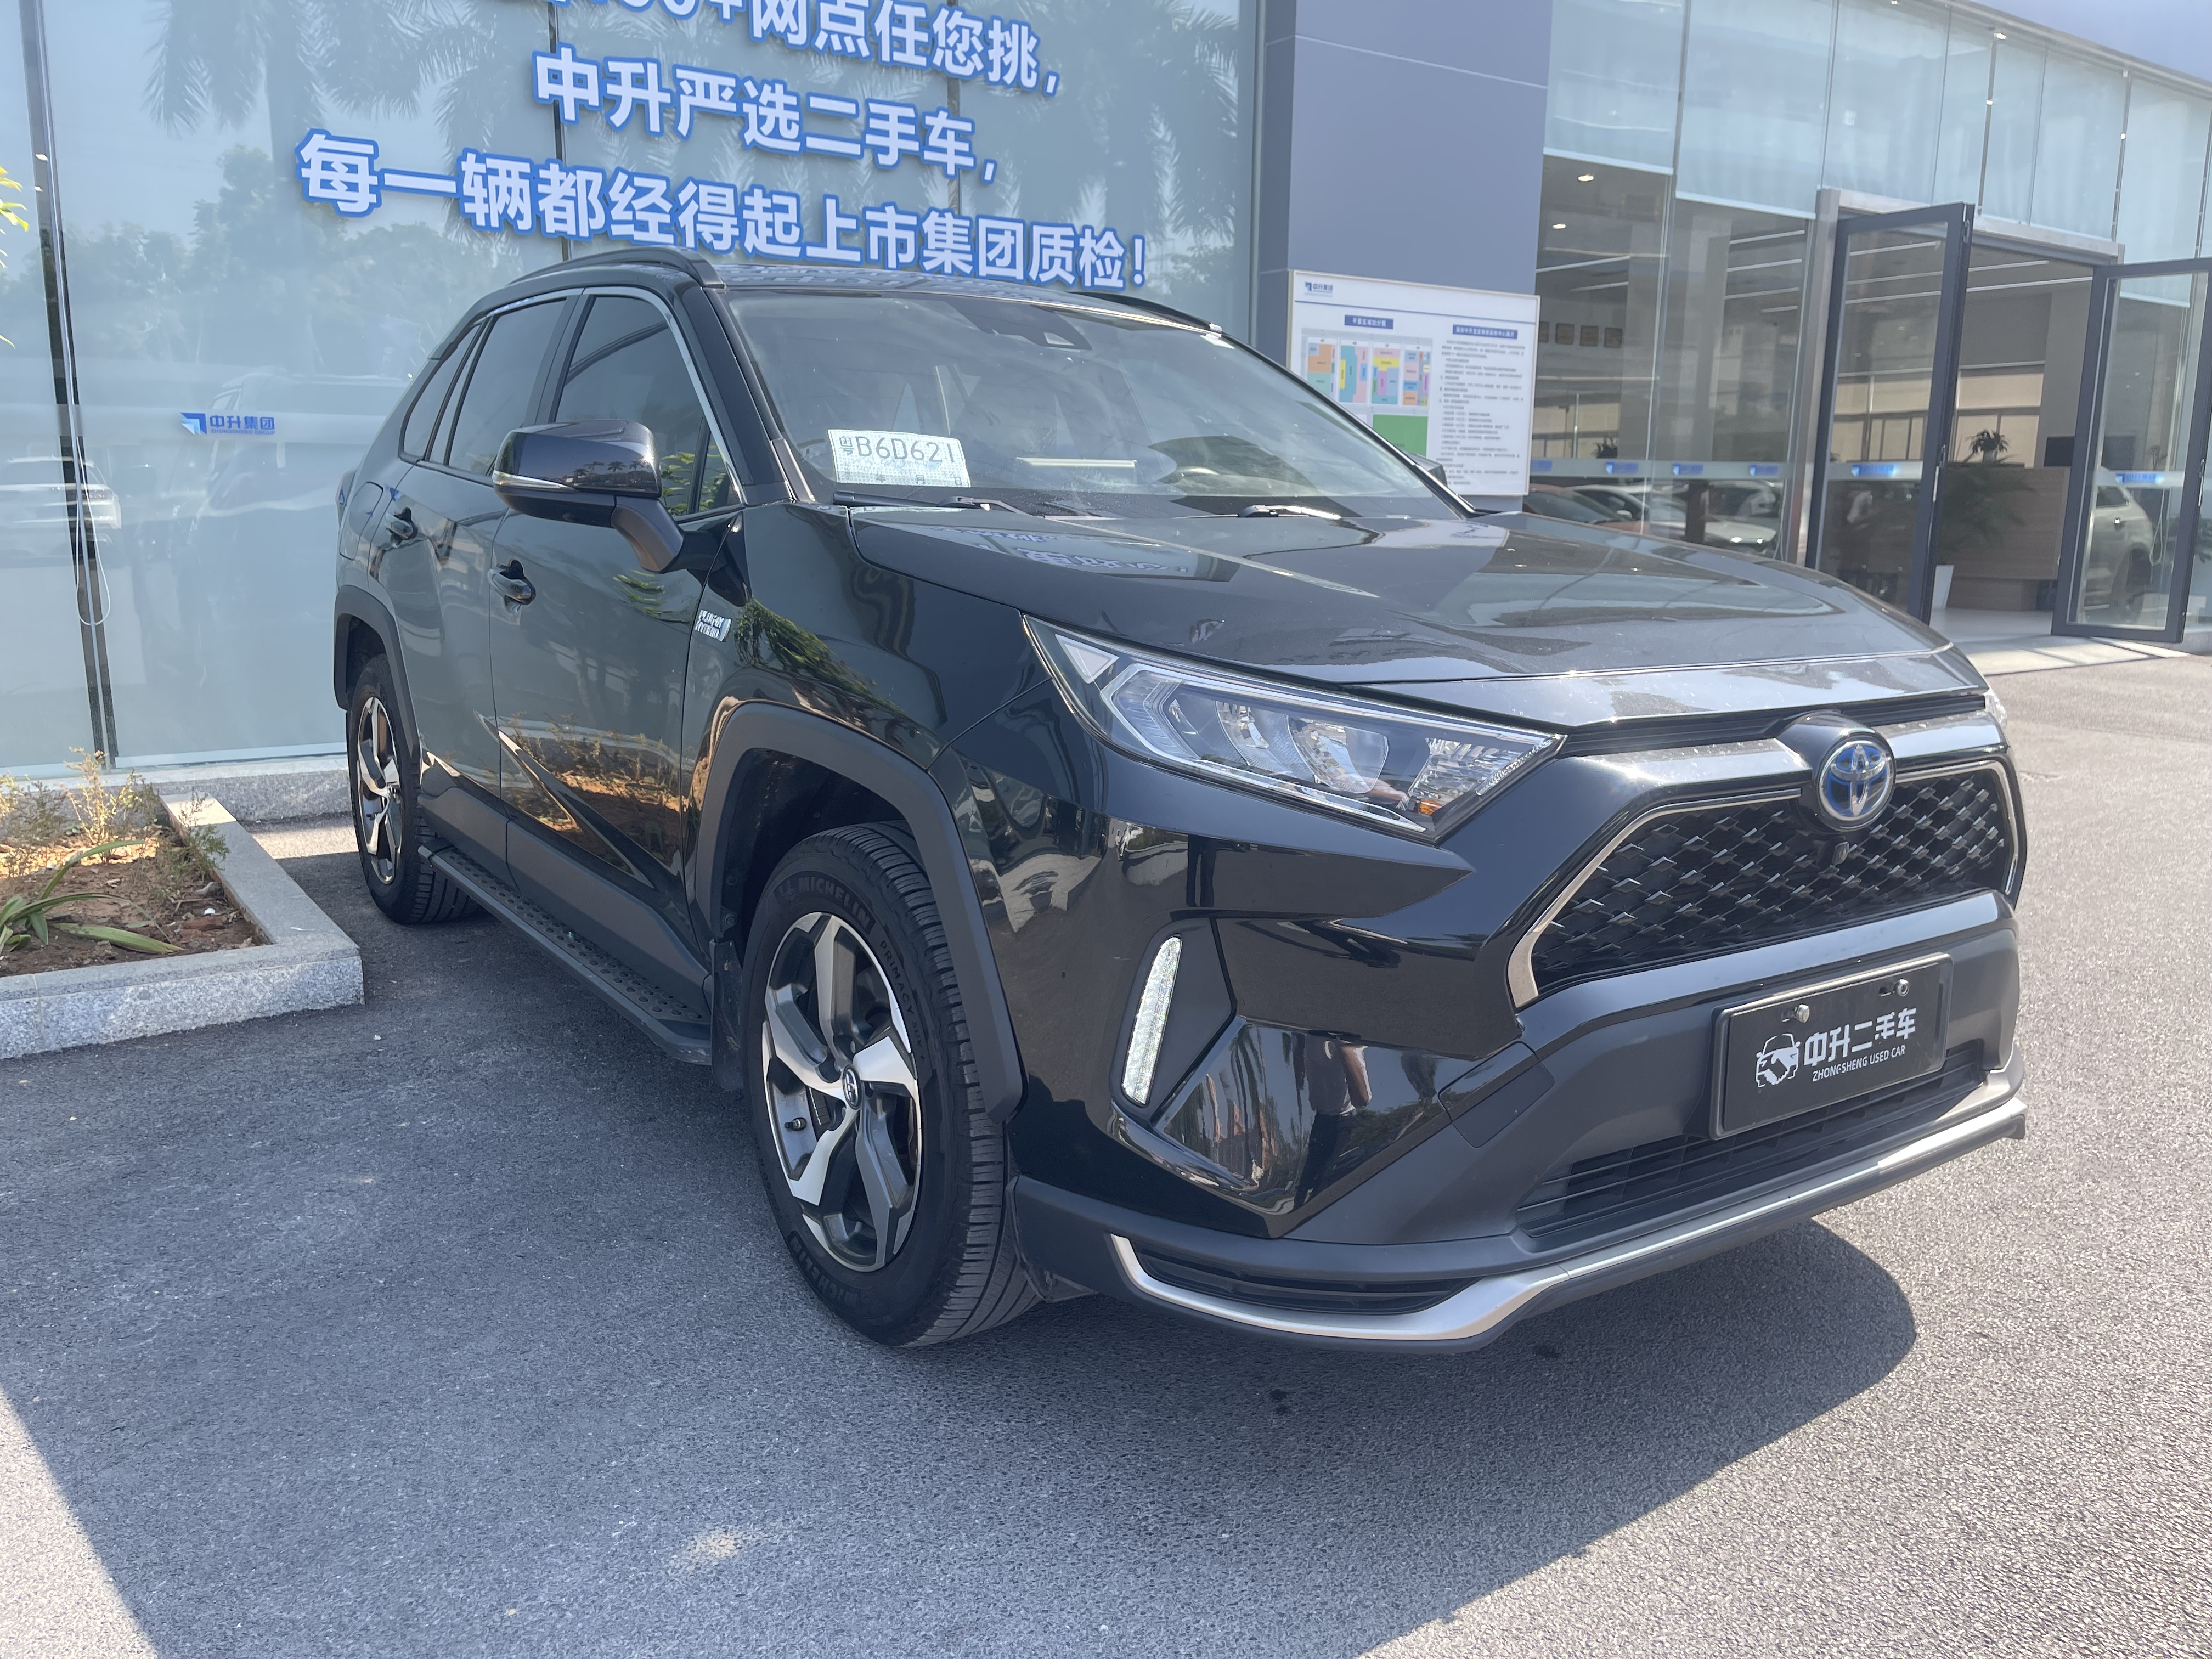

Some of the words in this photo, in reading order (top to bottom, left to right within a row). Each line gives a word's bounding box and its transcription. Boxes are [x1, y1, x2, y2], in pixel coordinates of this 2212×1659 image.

[534, 45, 996, 182] 中升严选二手车，
[299, 132, 1147, 289] 每一辆都经得起上市集团质检！
[209, 415, 275, 430] 中升集团
[798, 876, 871, 930] MICHELIN
[879, 939, 915, 1014] PRIMACY
[1803, 1007, 1917, 1067] 中升二手车
[1869, 1049, 1890, 1065] USED
[1891, 1044, 1906, 1058] CAR
[789, 1235, 859, 1309] MICHELIN
